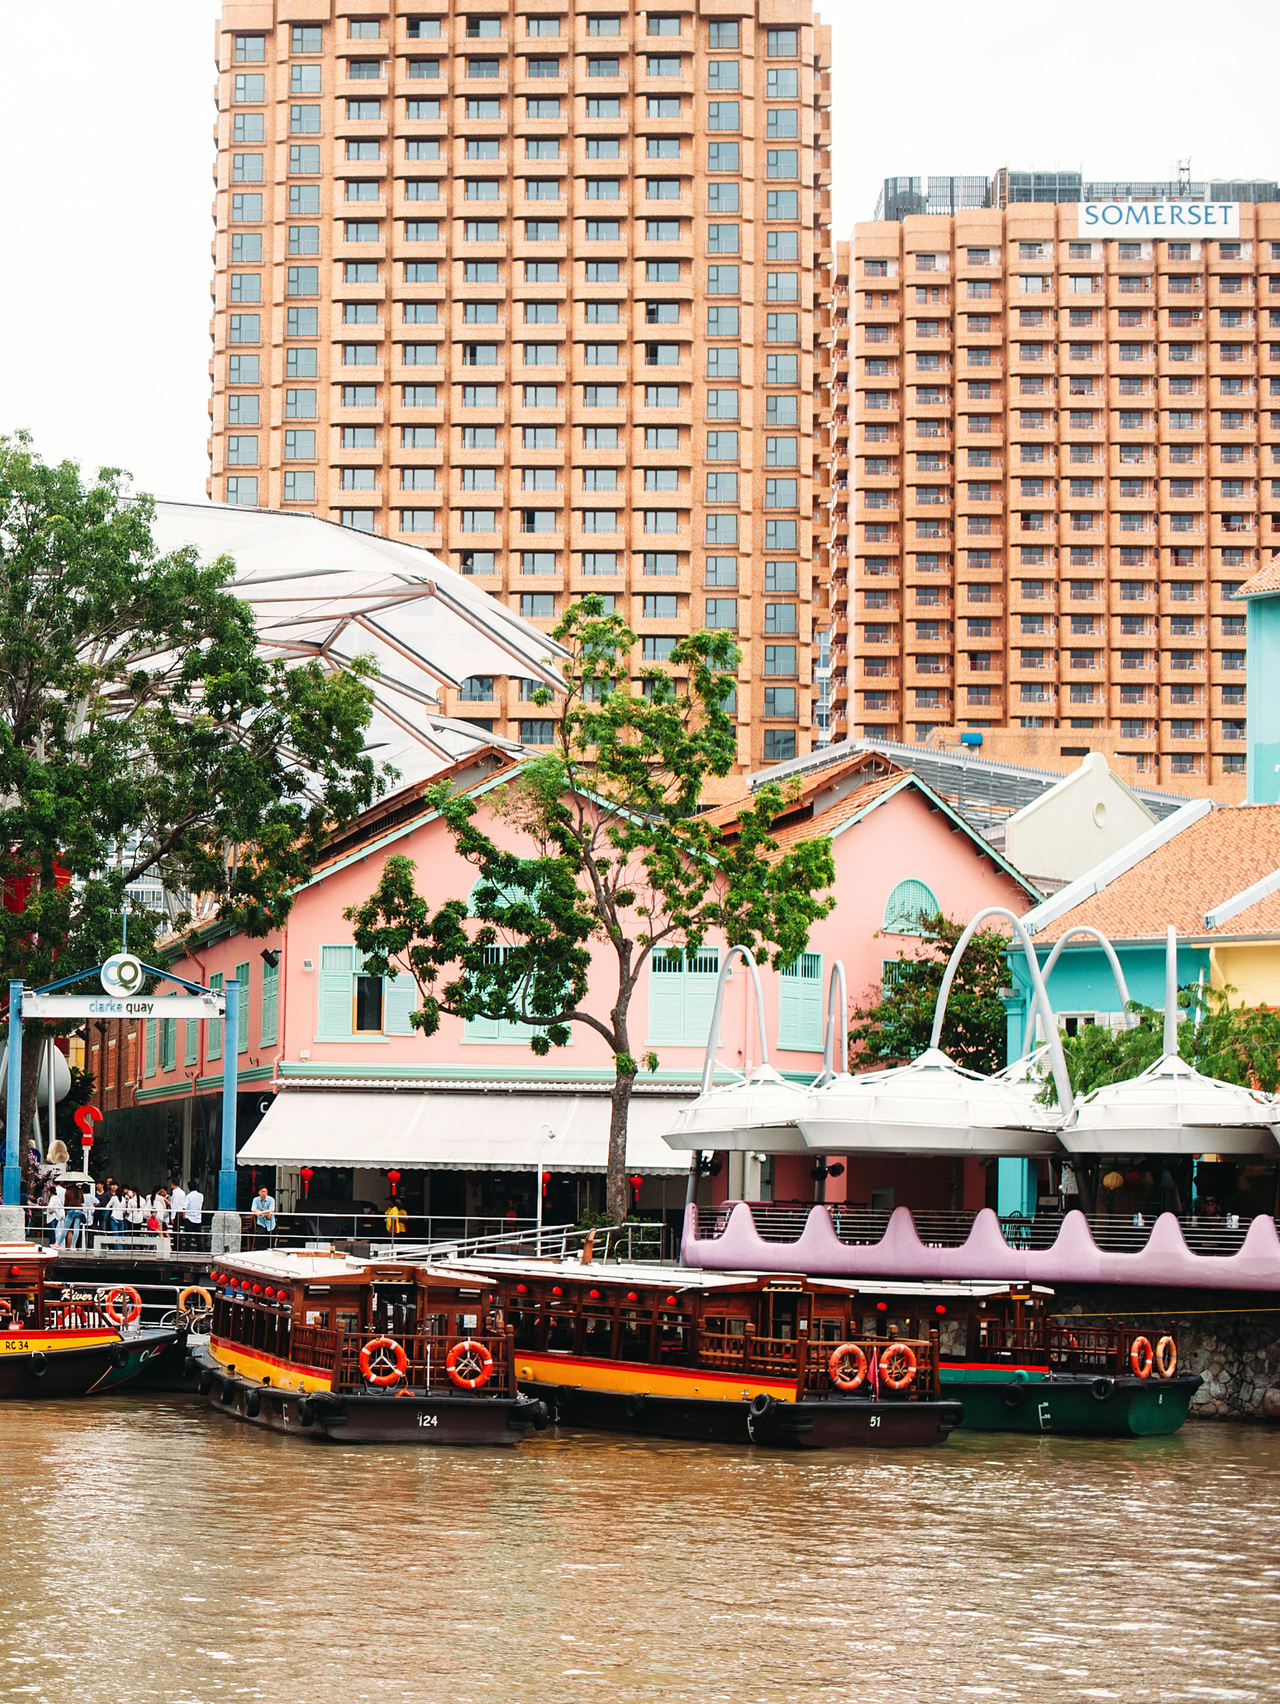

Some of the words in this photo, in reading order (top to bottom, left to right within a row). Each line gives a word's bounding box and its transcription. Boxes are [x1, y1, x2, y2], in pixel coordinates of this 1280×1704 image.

[1085, 205, 1233, 225] SOMERSET
[89, 999, 123, 1013] clarke
[126, 1001, 154, 1015] quay
[93, 1290, 130, 1303] Crise
[5, 1341, 16, 1350] RC
[18, 1341, 29, 1350] 34
[418, 1414, 439, 1427] 124
[869, 1415, 881, 1428] 51
